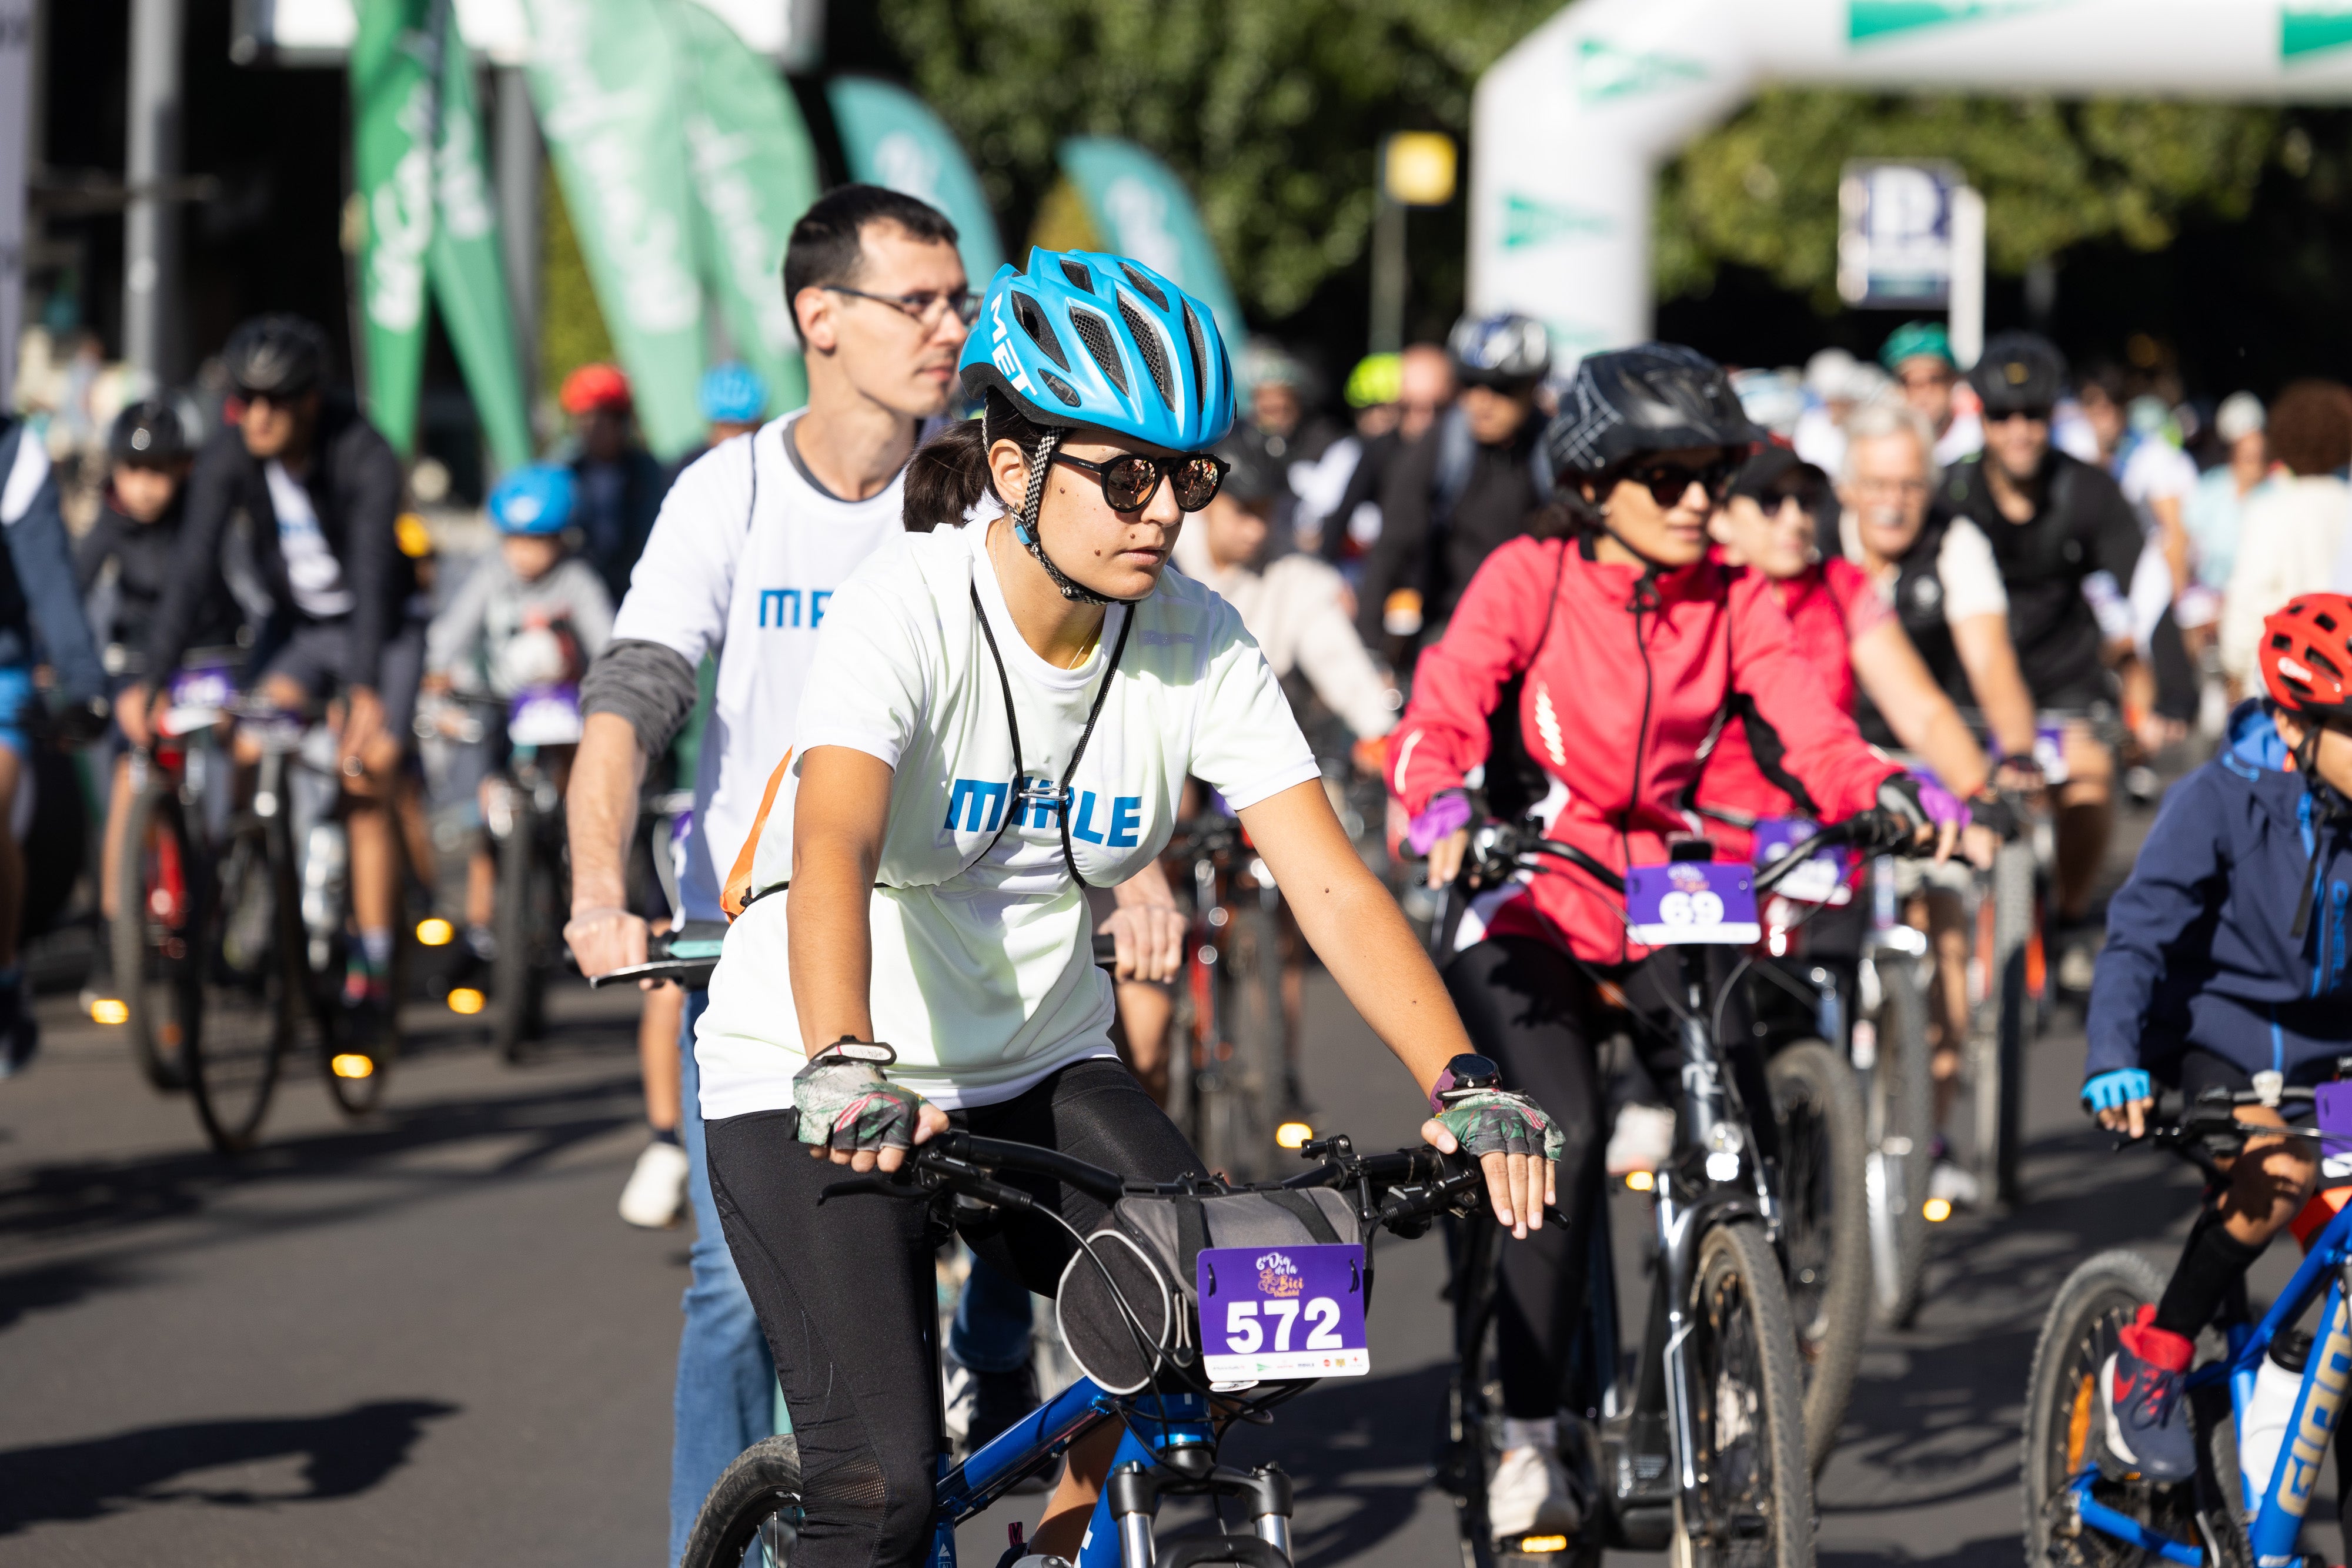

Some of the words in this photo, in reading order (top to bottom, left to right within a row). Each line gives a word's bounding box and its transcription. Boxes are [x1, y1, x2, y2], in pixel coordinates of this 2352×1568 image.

[991, 292, 1038, 396] MET
[1659, 890, 1725, 925] 69
[1278, 1273, 1304, 1291] Bici
[1225, 1297, 1343, 1354] 572
